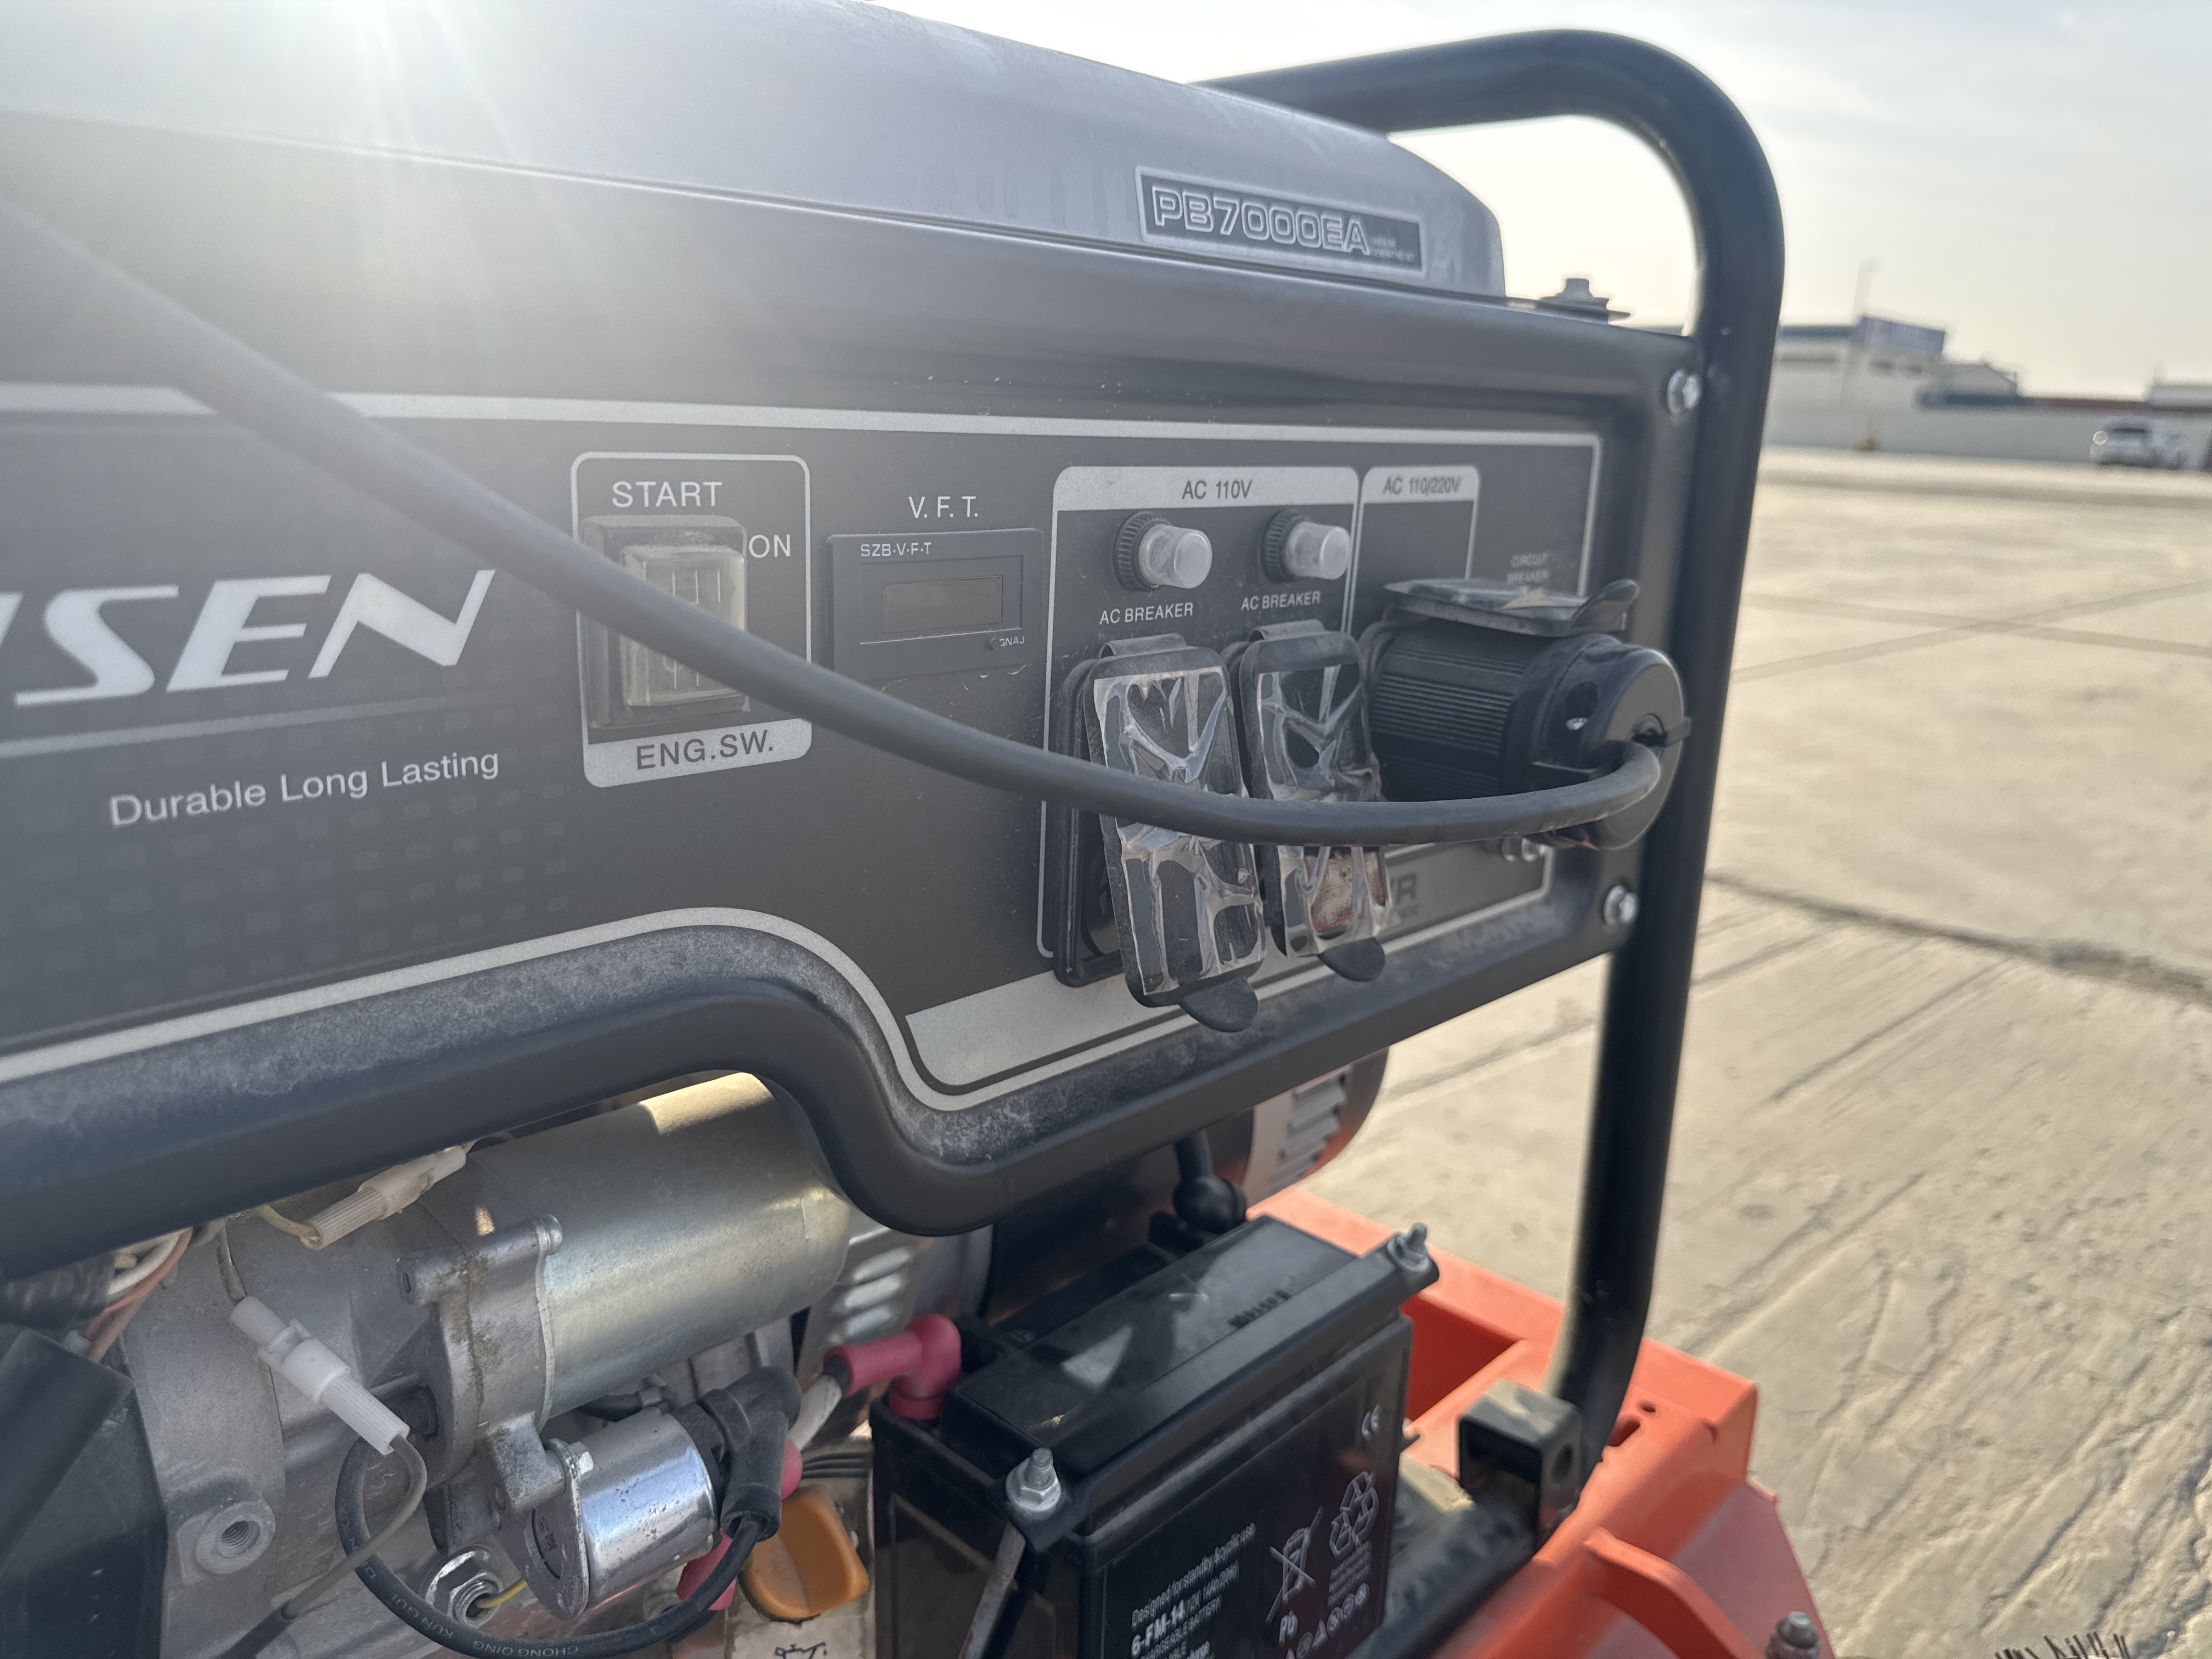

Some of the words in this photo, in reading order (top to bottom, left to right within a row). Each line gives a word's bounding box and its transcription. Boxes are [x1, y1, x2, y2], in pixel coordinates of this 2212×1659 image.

[1152, 186, 1370, 256] PB7000EA
[612, 481, 723, 508] START
[1182, 480, 1207, 500] AC
[1215, 479, 1253, 500] 110V
[1383, 476, 1403, 495] AC
[1408, 475, 1462, 496] 110/220V
[749, 534, 791, 558] ON
[1240, 596, 1260, 611] AC
[1261, 590, 1321, 610] BREAKER
[1099, 610, 1121, 625] AC
[1125, 602, 1194, 623] BREAKER
[637, 730, 775, 770] ENG.SW.
[110, 780, 267, 827] Durable
[280, 770, 369, 799] Long
[381, 752, 500, 788] Lasting
[518, 1645, 579, 1657] CHONG
